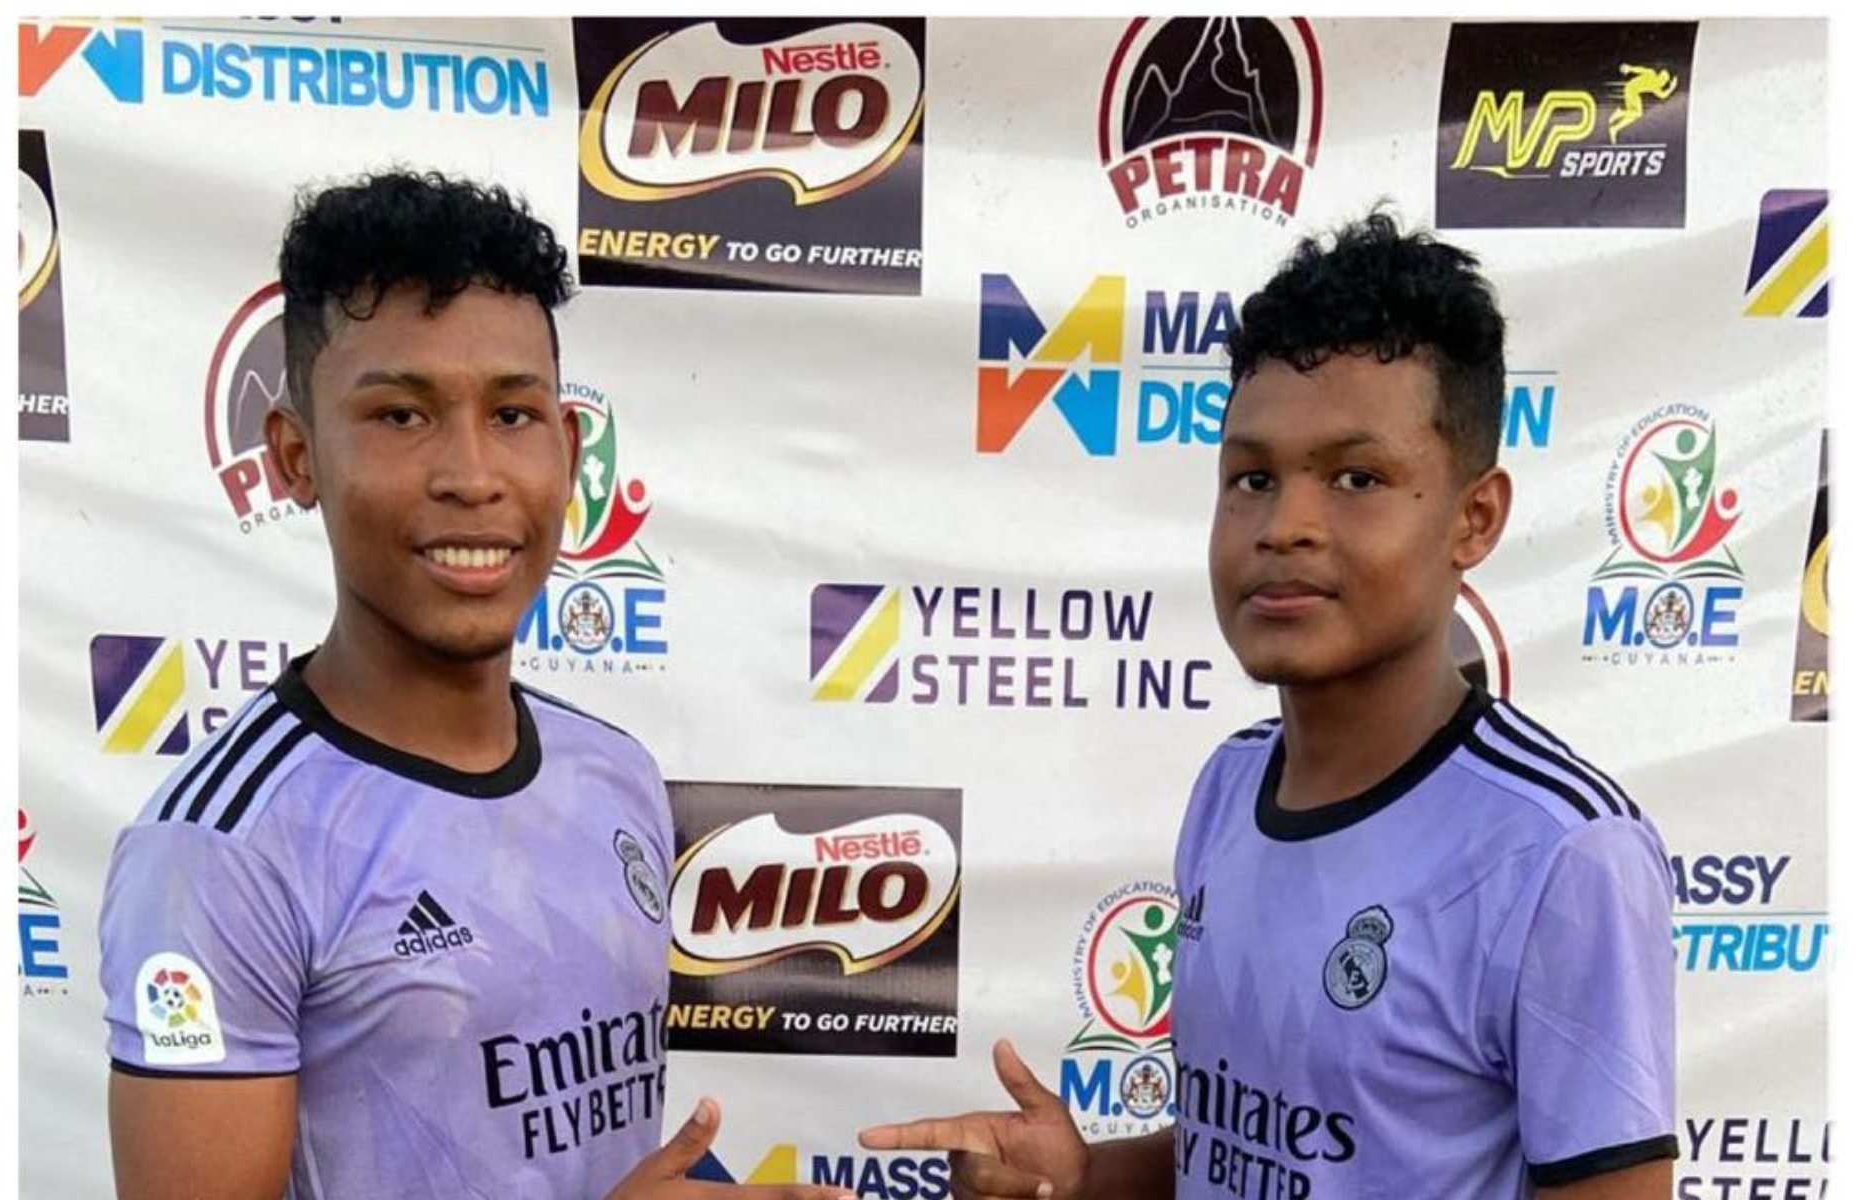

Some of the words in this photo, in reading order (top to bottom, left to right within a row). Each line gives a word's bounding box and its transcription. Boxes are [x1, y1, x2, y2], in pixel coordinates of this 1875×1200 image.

[161, 40, 550, 117] DISTRIBUTION
[763, 41, 881, 76] Nestlé
[628, 75, 890, 159] MILO
[1450, 90, 1598, 169] MVP
[1109, 137, 1308, 218] PETRA
[1560, 151, 1666, 177] SPORTS
[1126, 194, 1290, 230] ORGANISATION
[580, 227, 719, 259] ENERGY
[725, 240, 759, 261] TO
[765, 242, 801, 263] GO
[808, 244, 922, 268] FURTHER
[1631, 403, 1710, 438] EDUCATION
[913, 586, 1153, 640] YELLOW
[530, 657, 633, 675] GUYANA
[912, 655, 1088, 708] STEEL
[1116, 657, 1213, 709] INC
[815, 832, 920, 863] Nestlé
[691, 861, 930, 934] MILO
[1672, 856, 1792, 904] ASSY
[394, 928, 474, 957] adidas
[1073, 931, 1094, 1020] MINISTRY
[1084, 913, 1099, 934] OF
[1097, 882, 1178, 914] EDUCATION
[667, 1005, 775, 1031] NERGY
[781, 1011, 811, 1031] TO
[816, 1011, 849, 1032] GO
[854, 1014, 958, 1035] FURTHER
[522, 1098, 583, 1160] FLY
[588, 1066, 666, 1137] BETT
[1176, 1057, 1357, 1163] mirates
[1686, 1119, 1829, 1164] YELL
[813, 1156, 950, 1200] MASS
